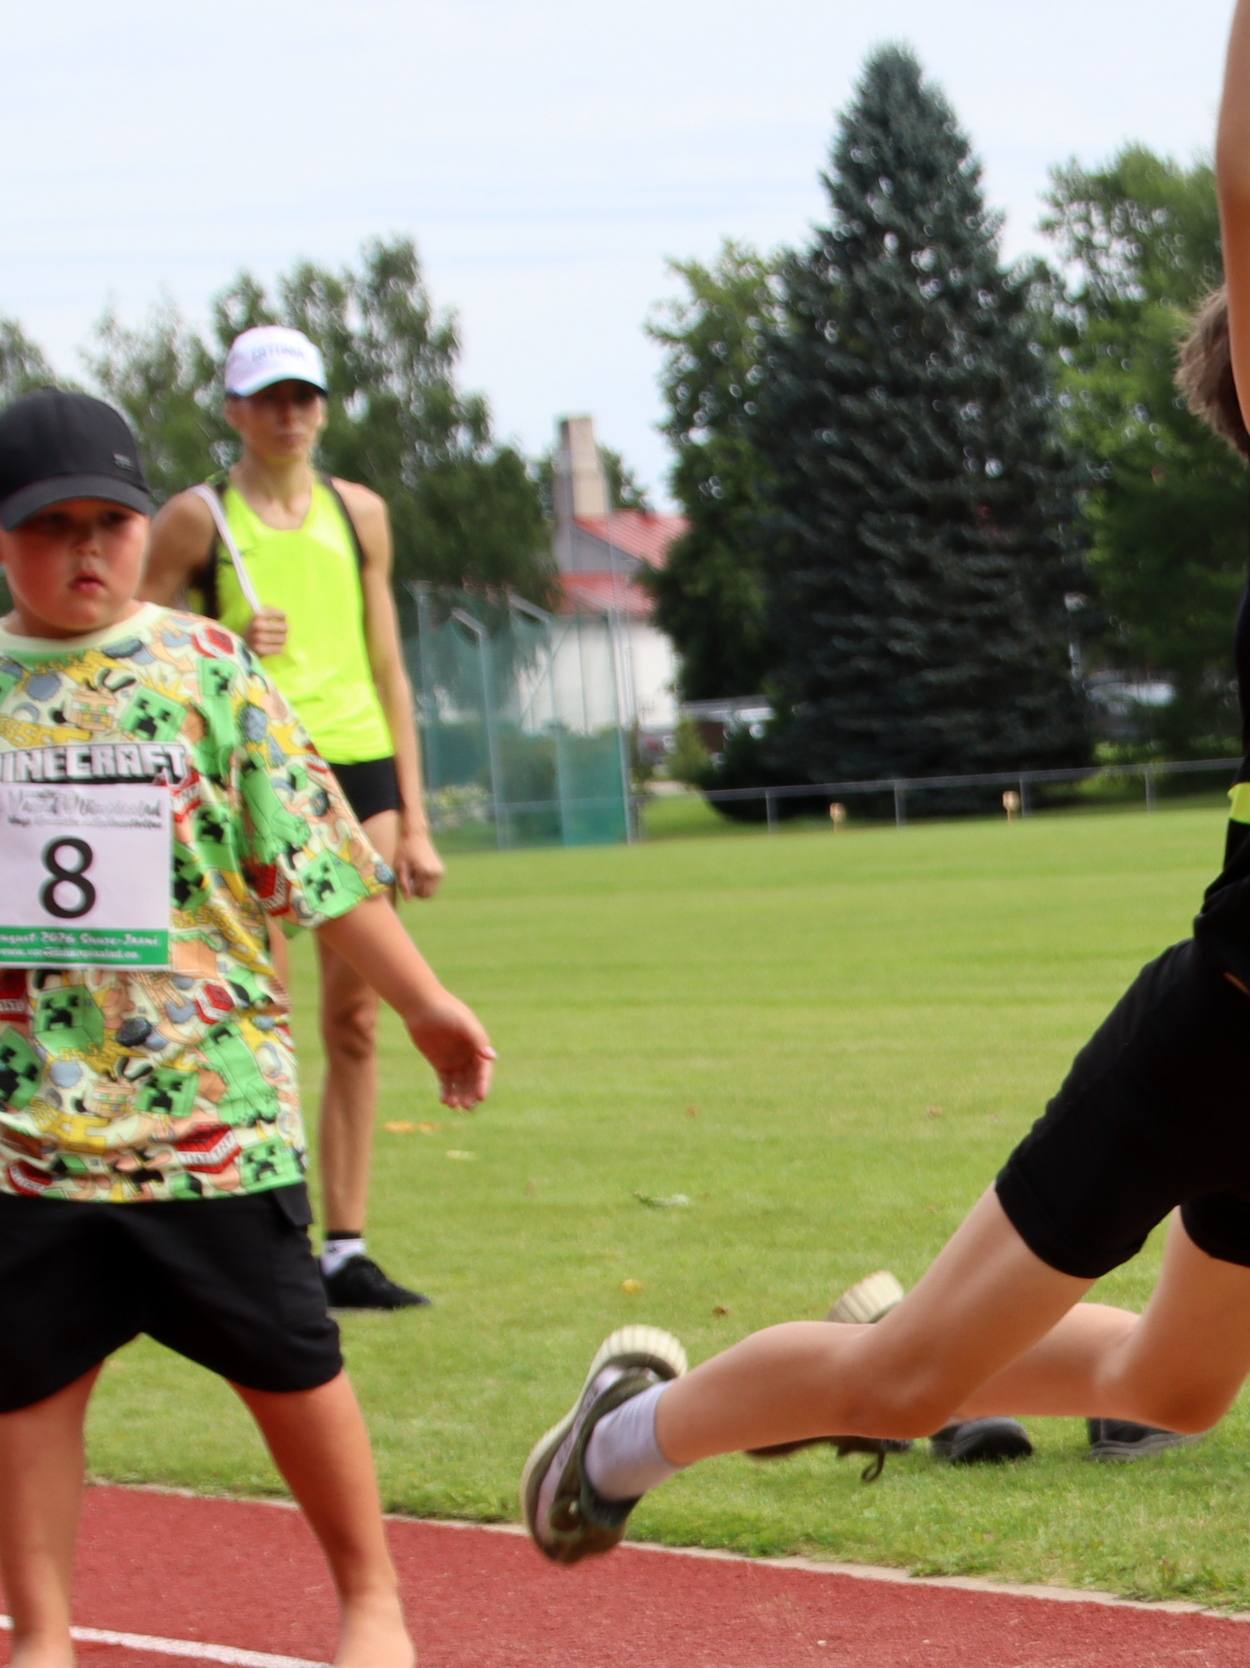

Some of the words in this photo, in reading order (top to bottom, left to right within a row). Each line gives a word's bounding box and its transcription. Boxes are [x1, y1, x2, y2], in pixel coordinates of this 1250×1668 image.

[0, 744, 187, 784] INECRAFT
[40, 835, 96, 919] 8
[0, 931, 36, 945] ugust
